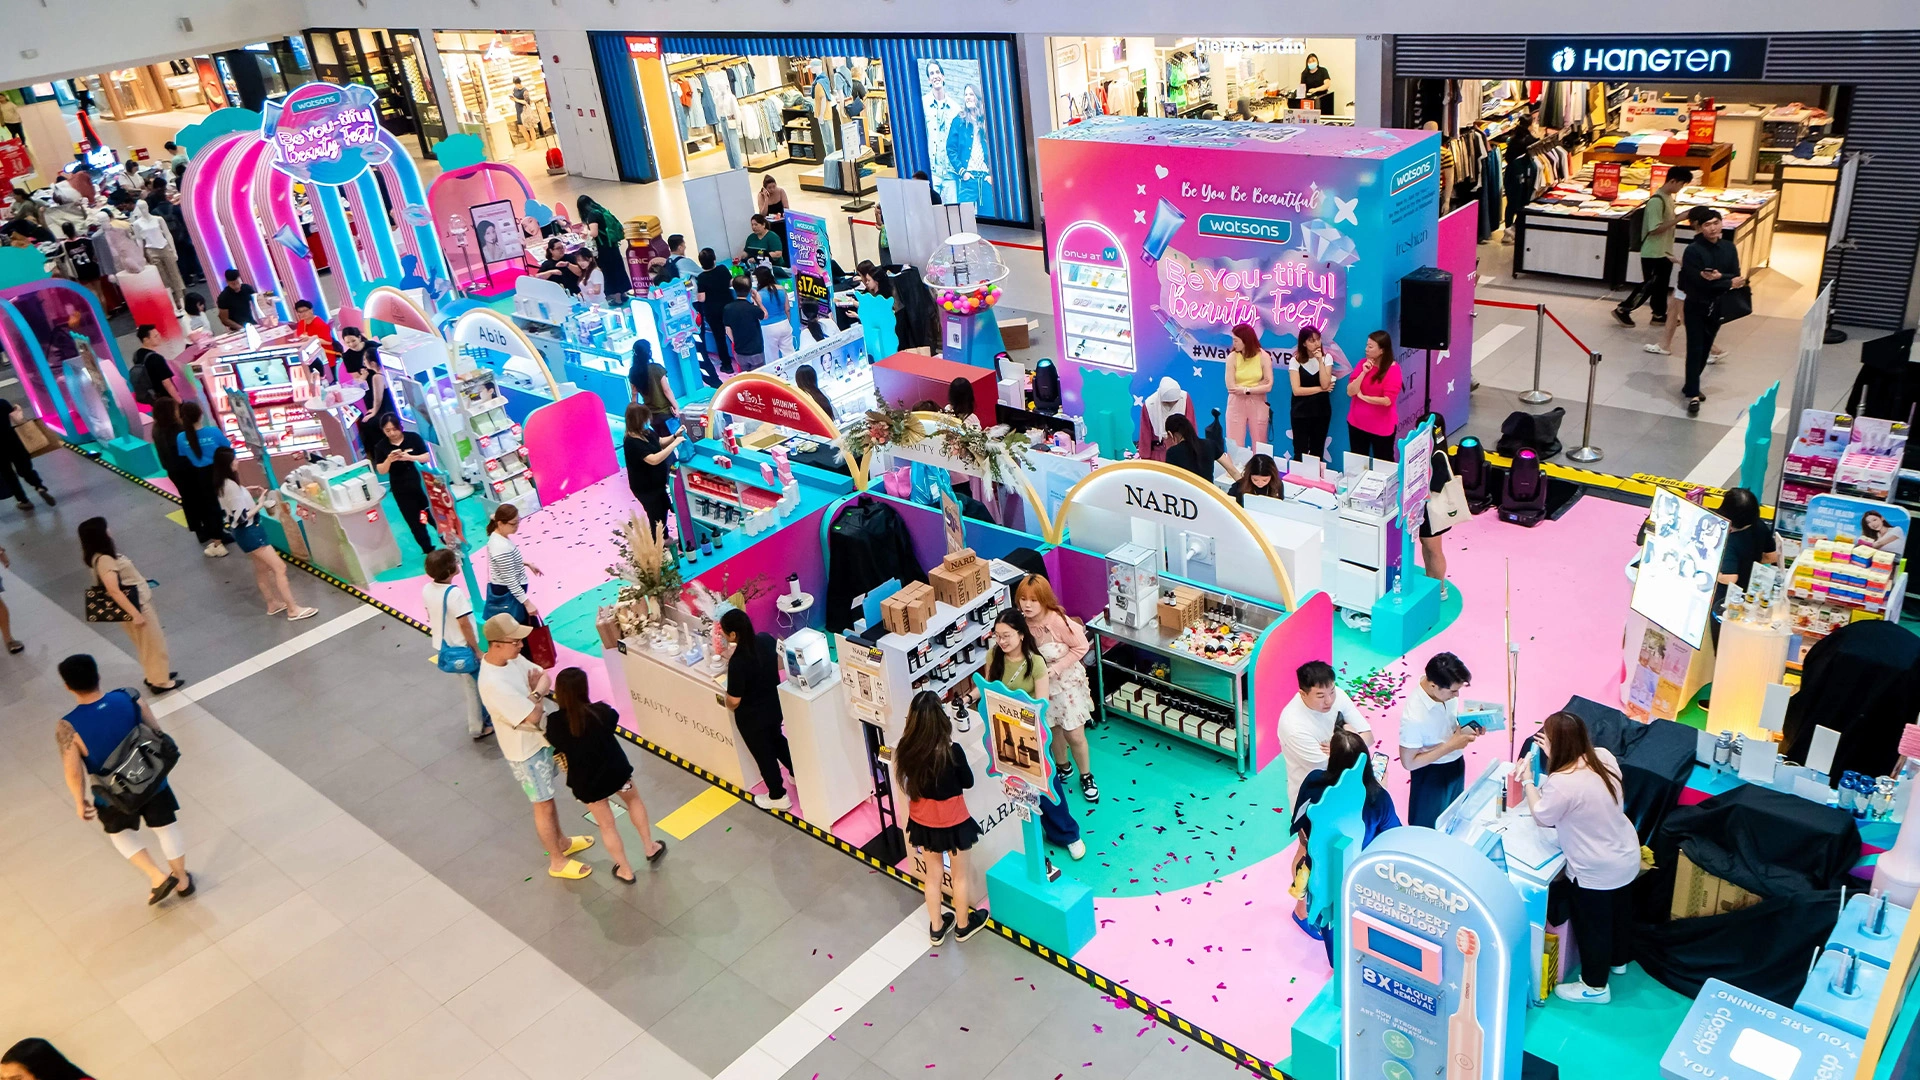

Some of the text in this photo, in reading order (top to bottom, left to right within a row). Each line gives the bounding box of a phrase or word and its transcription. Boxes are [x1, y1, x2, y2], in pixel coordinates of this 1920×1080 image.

[297, 95, 337, 110] watsons
[285, 122, 375, 164] Beauty Fest
[1396, 161, 1431, 187] watsons
[1181, 181, 1321, 213] Be You Be Beautiful
[796, 222, 815, 231] watsons
[1209, 219, 1280, 238] watsons
[1104, 250, 1116, 260] W
[798, 275, 827, 297] $17 OFF
[1168, 282, 1335, 334] Beauty Fest
[479, 325, 507, 346] Abib
[900, 443, 935, 455] EAUTY
[1124, 484, 1199, 520] NARD
[950, 555, 976, 570] NARD
[956, 580, 967, 606] NARD
[974, 569, 983, 596] NARD
[901, 606, 911, 633] NARD
[630, 689, 735, 748] BEAUTY OF JOSEON
[998, 704, 1022, 720] NAR
[1374, 863, 1470, 915] closeup
[1354, 883, 1452, 932] SONIC EXPERT
[1358, 894, 1448, 939] TECHNOLOGY
[1363, 967, 1434, 1006] 8X PLAQUE
[1360, 1007, 1375, 1018] ARE
[1377, 1014, 1391, 1026] THE
[1375, 1008, 1422, 1034] HOW STRONG
[1717, 990, 1852, 1054] YOU ARE SHINING
[1696, 1006, 1735, 1056] closeup
[1682, 1056, 1716, 1078] YOU
